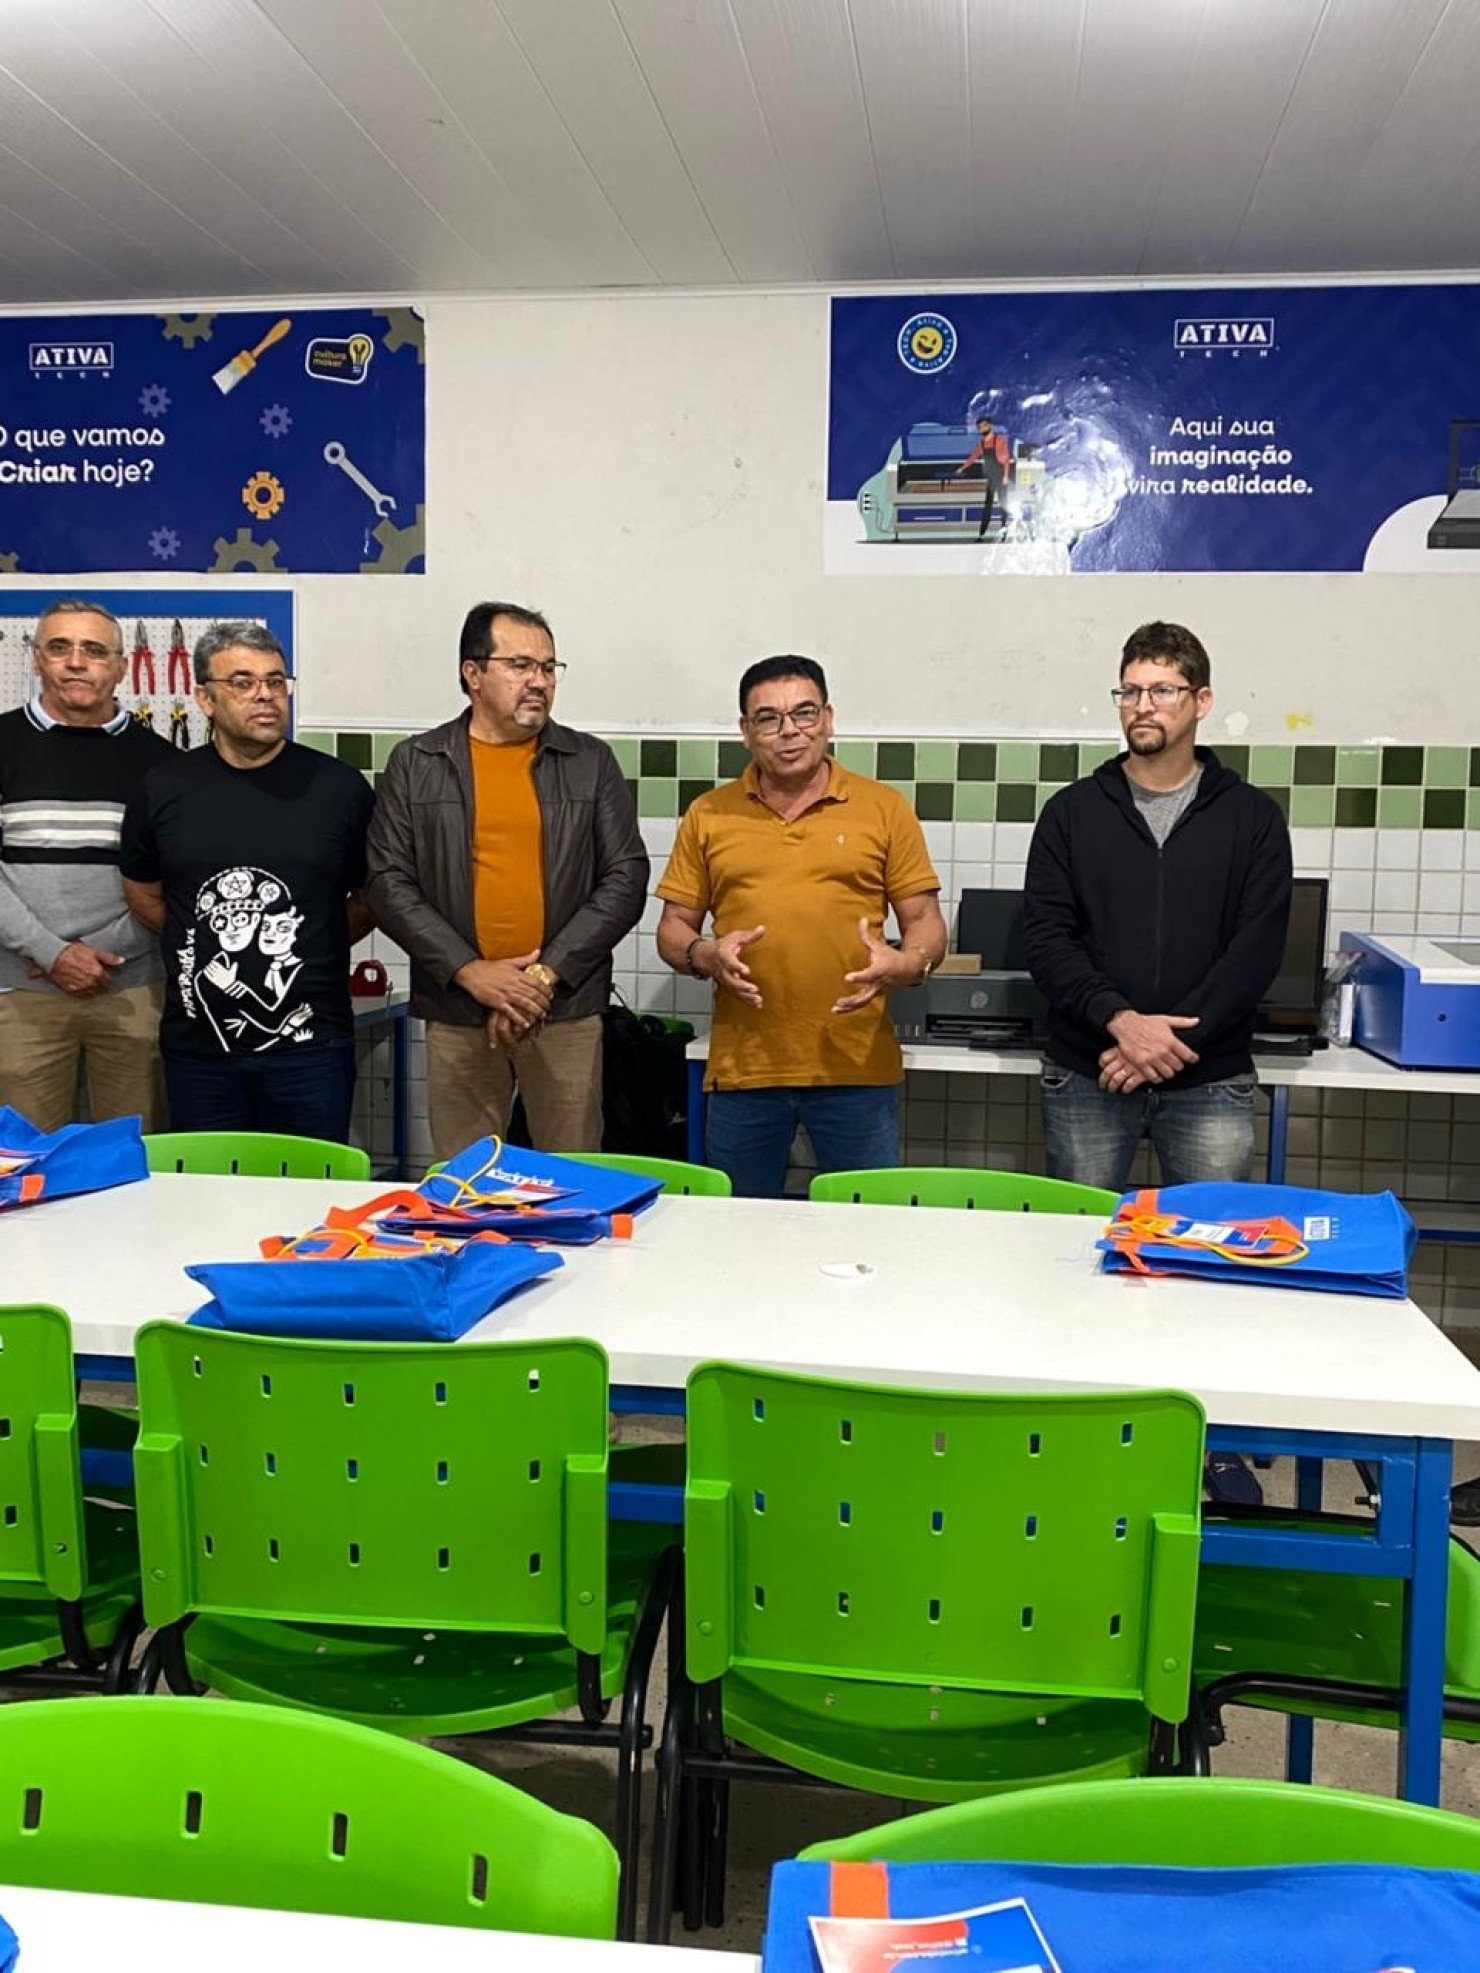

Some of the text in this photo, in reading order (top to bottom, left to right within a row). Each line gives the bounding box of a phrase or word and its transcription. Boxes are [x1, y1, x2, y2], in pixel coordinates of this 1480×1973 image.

[1180, 323, 1267, 342] ATIVA
[34, 347, 109, 365] ATIVA
[14, 429, 66, 452] que
[72, 428, 165, 447] vamos
[1169, 416, 1275, 440] Aqui sua
[1150, 445, 1292, 471] imaginação
[0, 458, 154, 488] Criar hoje?
[1128, 473, 1314, 495] vira realidade.
